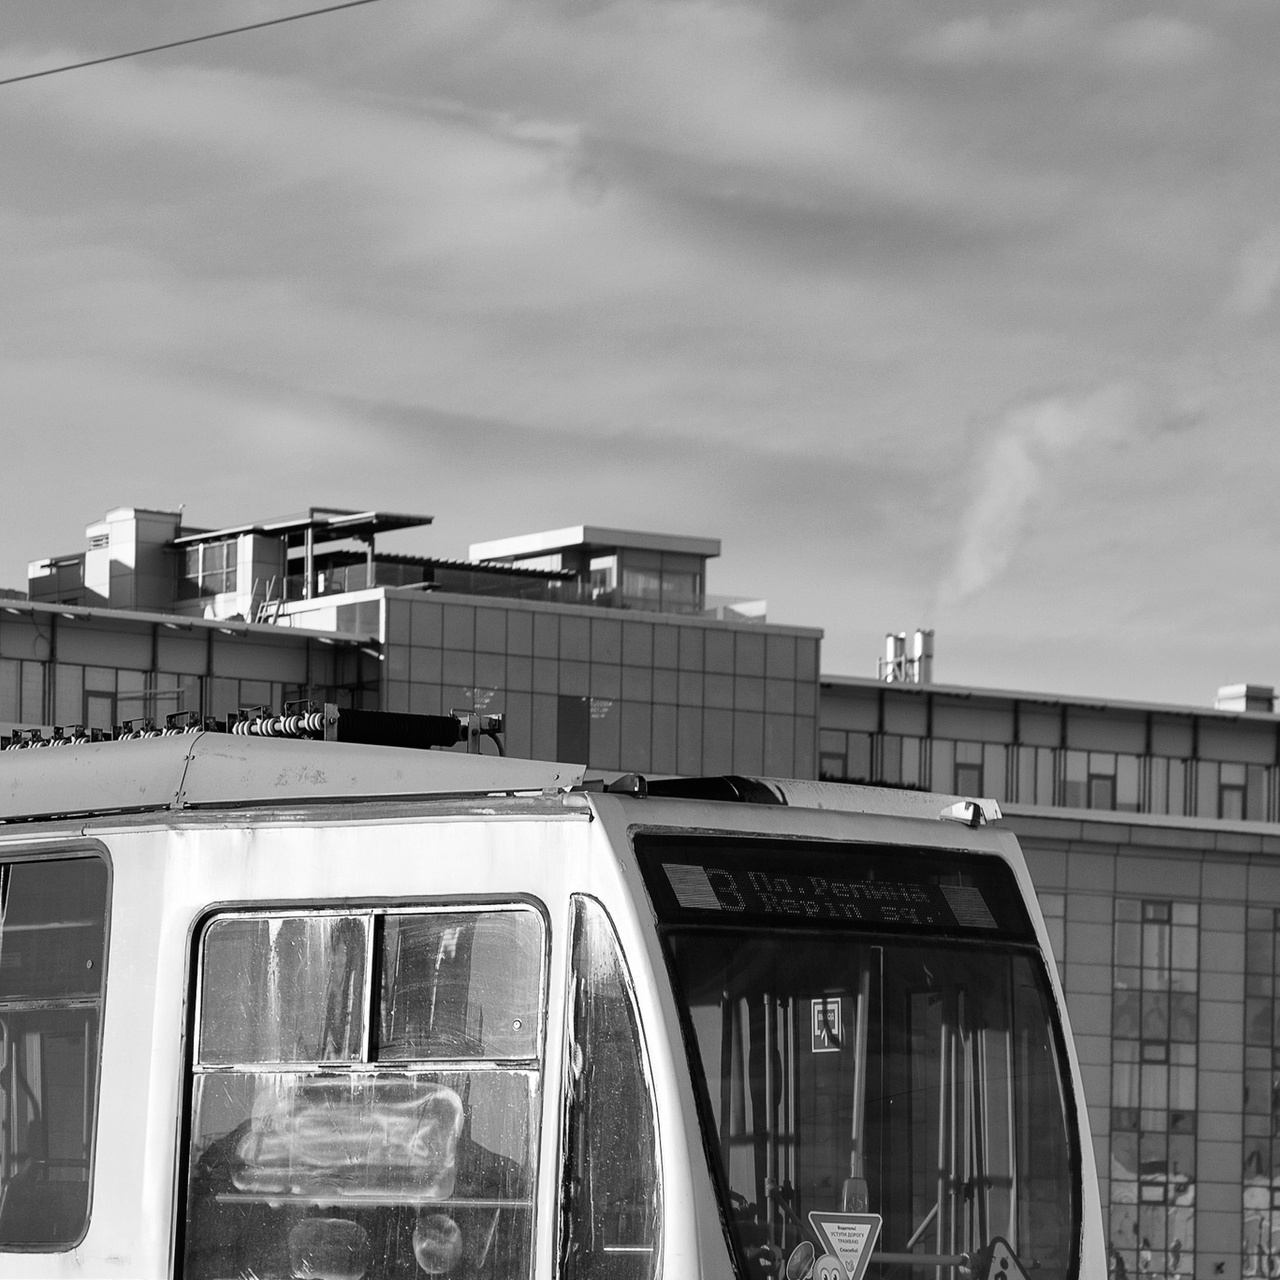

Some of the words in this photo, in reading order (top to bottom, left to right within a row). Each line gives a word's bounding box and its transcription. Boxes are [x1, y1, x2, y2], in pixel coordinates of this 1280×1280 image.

[747, 871, 805, 894] Пл.
[758, 891, 862, 918] Repin
[881, 906, 934, 925] sq.
